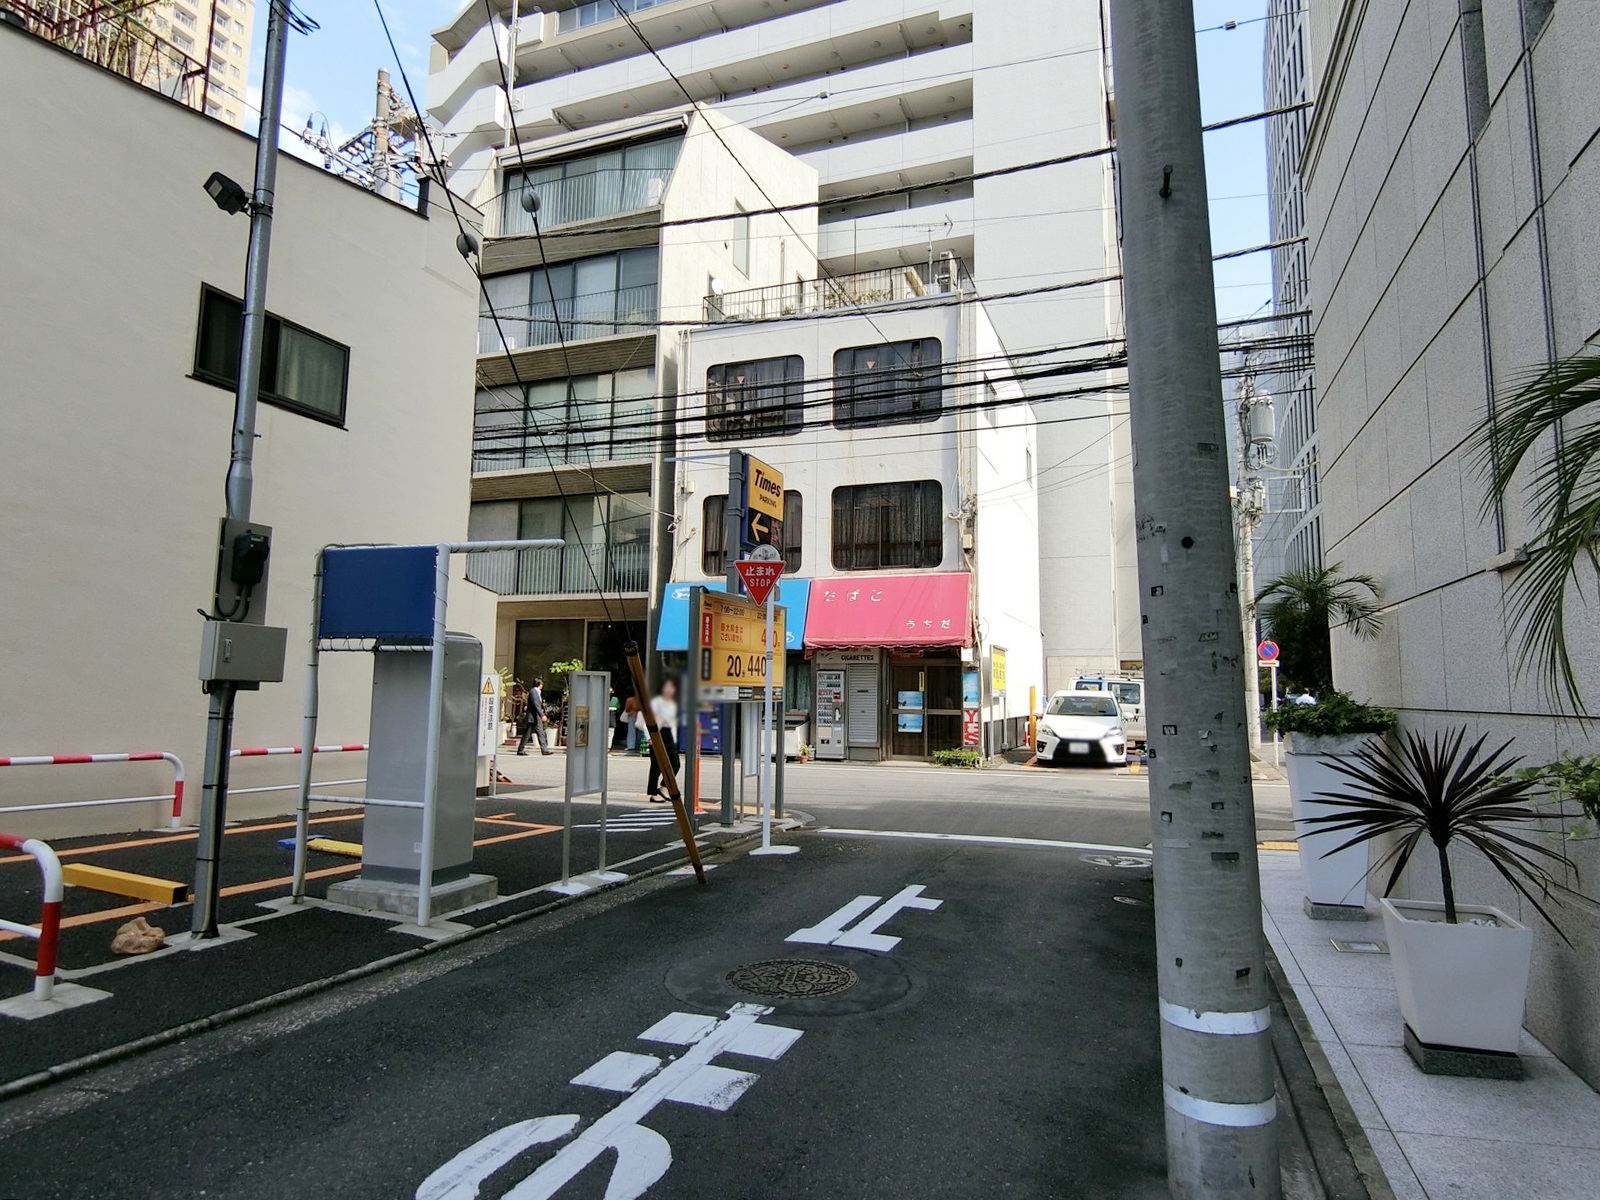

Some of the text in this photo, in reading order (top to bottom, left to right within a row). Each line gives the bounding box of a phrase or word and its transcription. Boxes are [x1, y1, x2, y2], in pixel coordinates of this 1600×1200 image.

[754, 468, 782, 498] Times
[759, 493, 777, 508] PARKING
[744, 565, 776, 577] 止まれ
[749, 578, 771, 587] STOP
[905, 618, 951, 630] うちだ
[963, 710, 979, 746] YES
